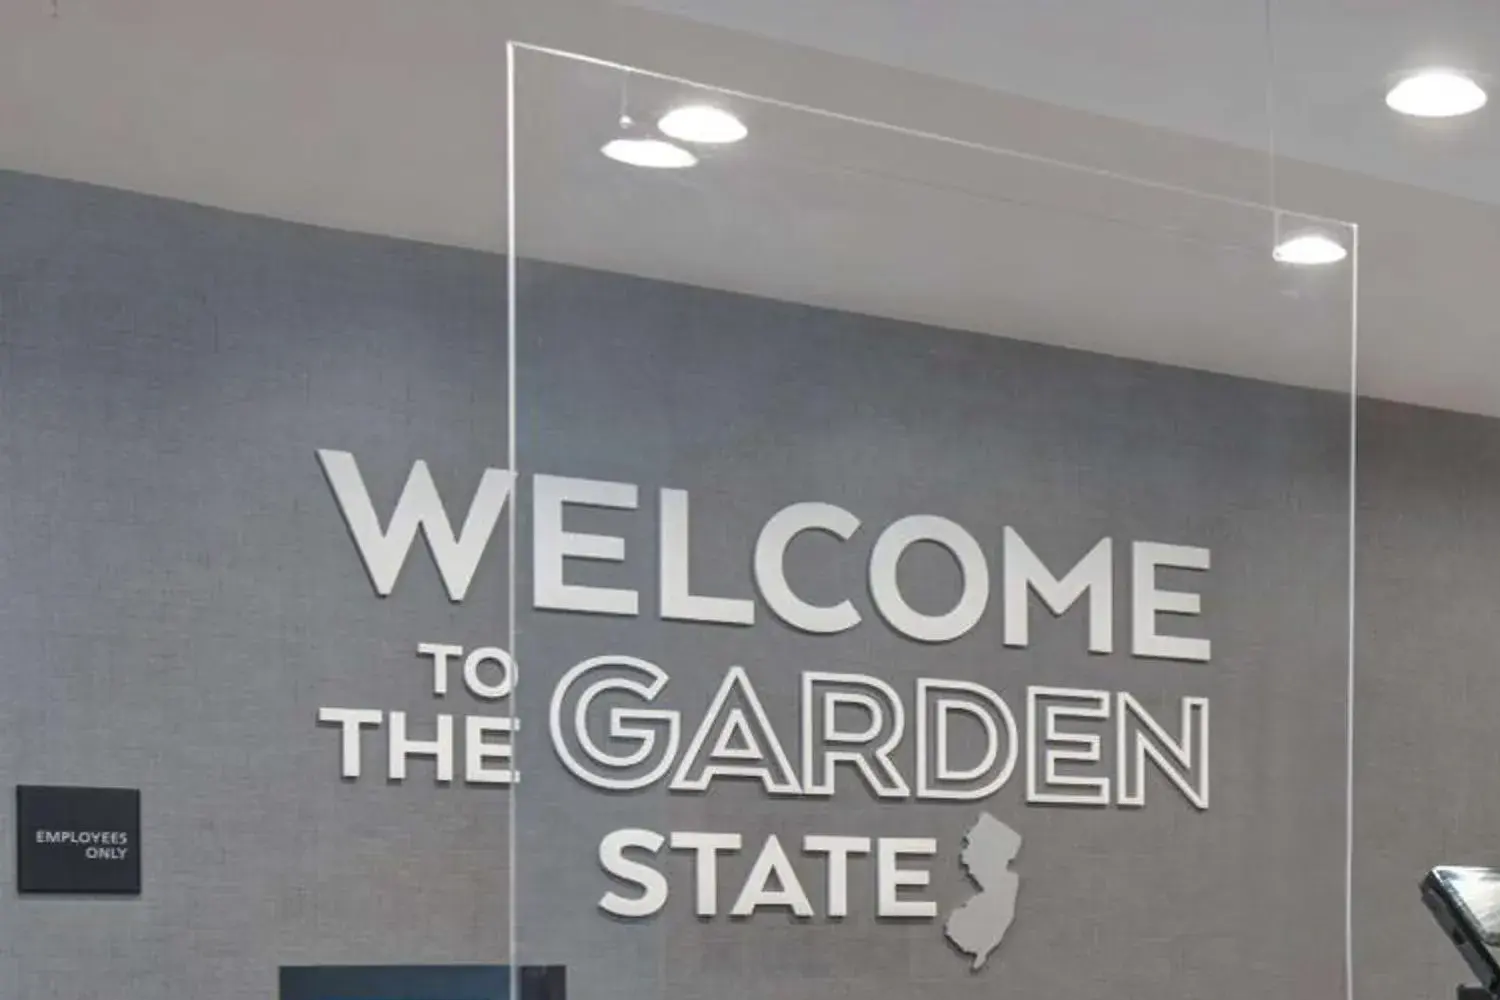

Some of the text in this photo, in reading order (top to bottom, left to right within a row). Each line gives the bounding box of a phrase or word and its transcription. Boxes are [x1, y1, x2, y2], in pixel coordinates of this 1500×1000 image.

[316, 447, 1212, 662] WELCOME
[417, 642, 520, 699] TO
[318, 655, 1210, 810] THE GARDEN
[35, 830, 128, 845] EMPLOYEES
[85, 846, 128, 860] ONLY
[598, 828, 938, 918] STATE
